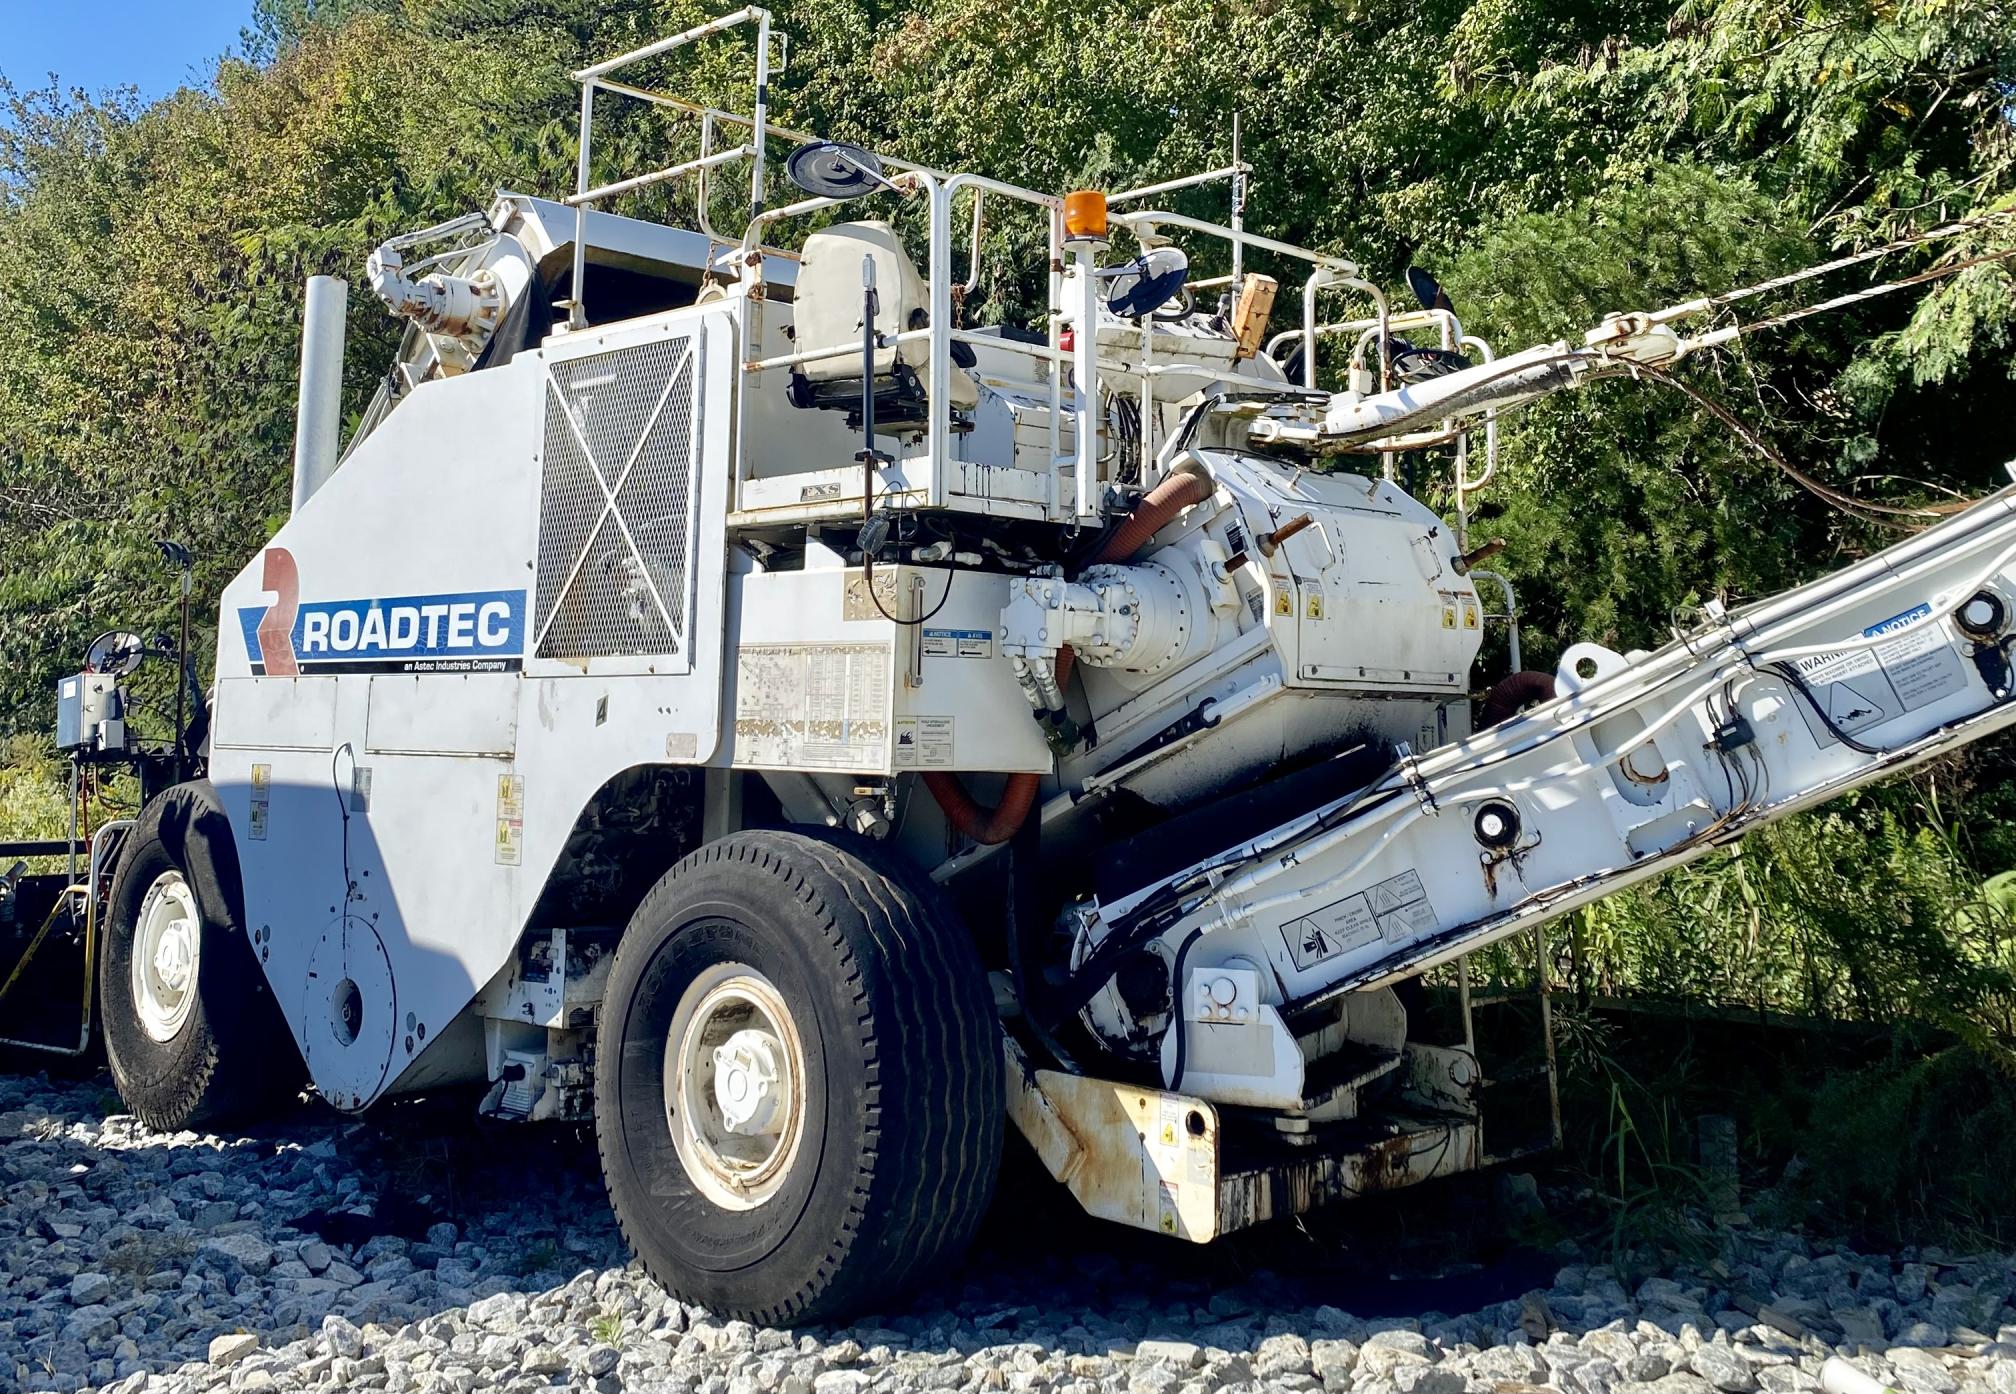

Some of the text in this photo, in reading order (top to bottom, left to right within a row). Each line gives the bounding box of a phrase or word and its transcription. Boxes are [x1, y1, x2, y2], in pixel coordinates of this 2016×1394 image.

[303, 601, 511, 652] ROADTEC
[404, 660, 507, 672] an Astec Industries Company
